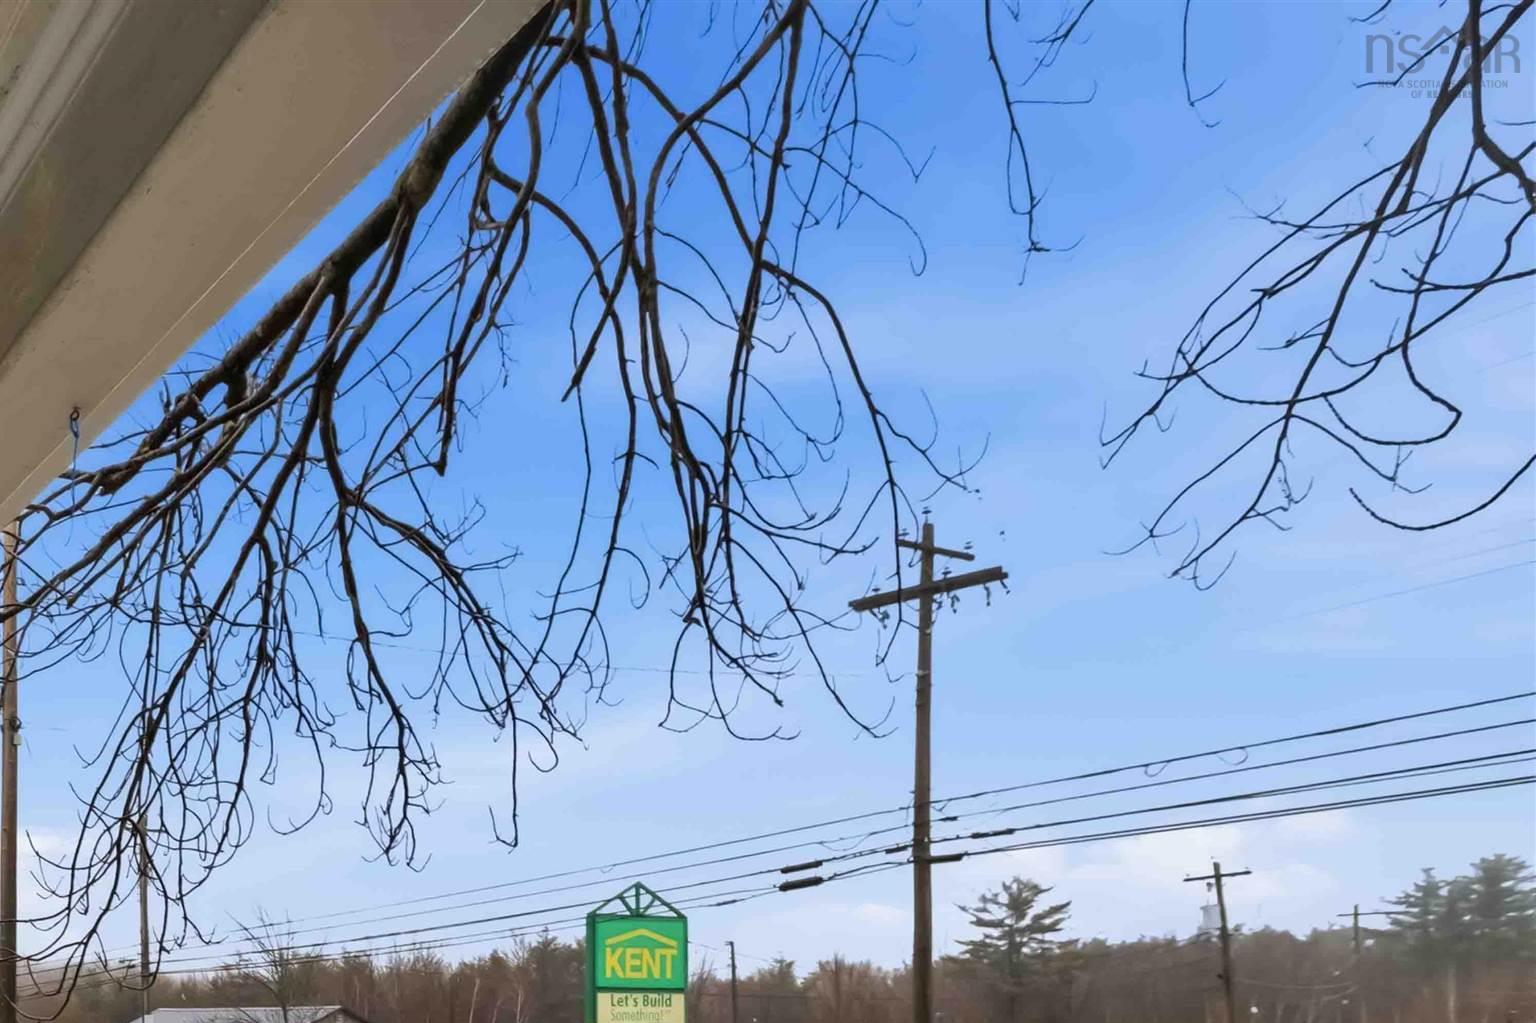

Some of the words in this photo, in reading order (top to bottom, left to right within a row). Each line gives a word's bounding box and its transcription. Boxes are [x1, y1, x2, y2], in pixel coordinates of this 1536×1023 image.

[606, 947, 677, 979] KENT
[611, 993, 639, 1007] Let's
[643, 992, 672, 1007] Build
